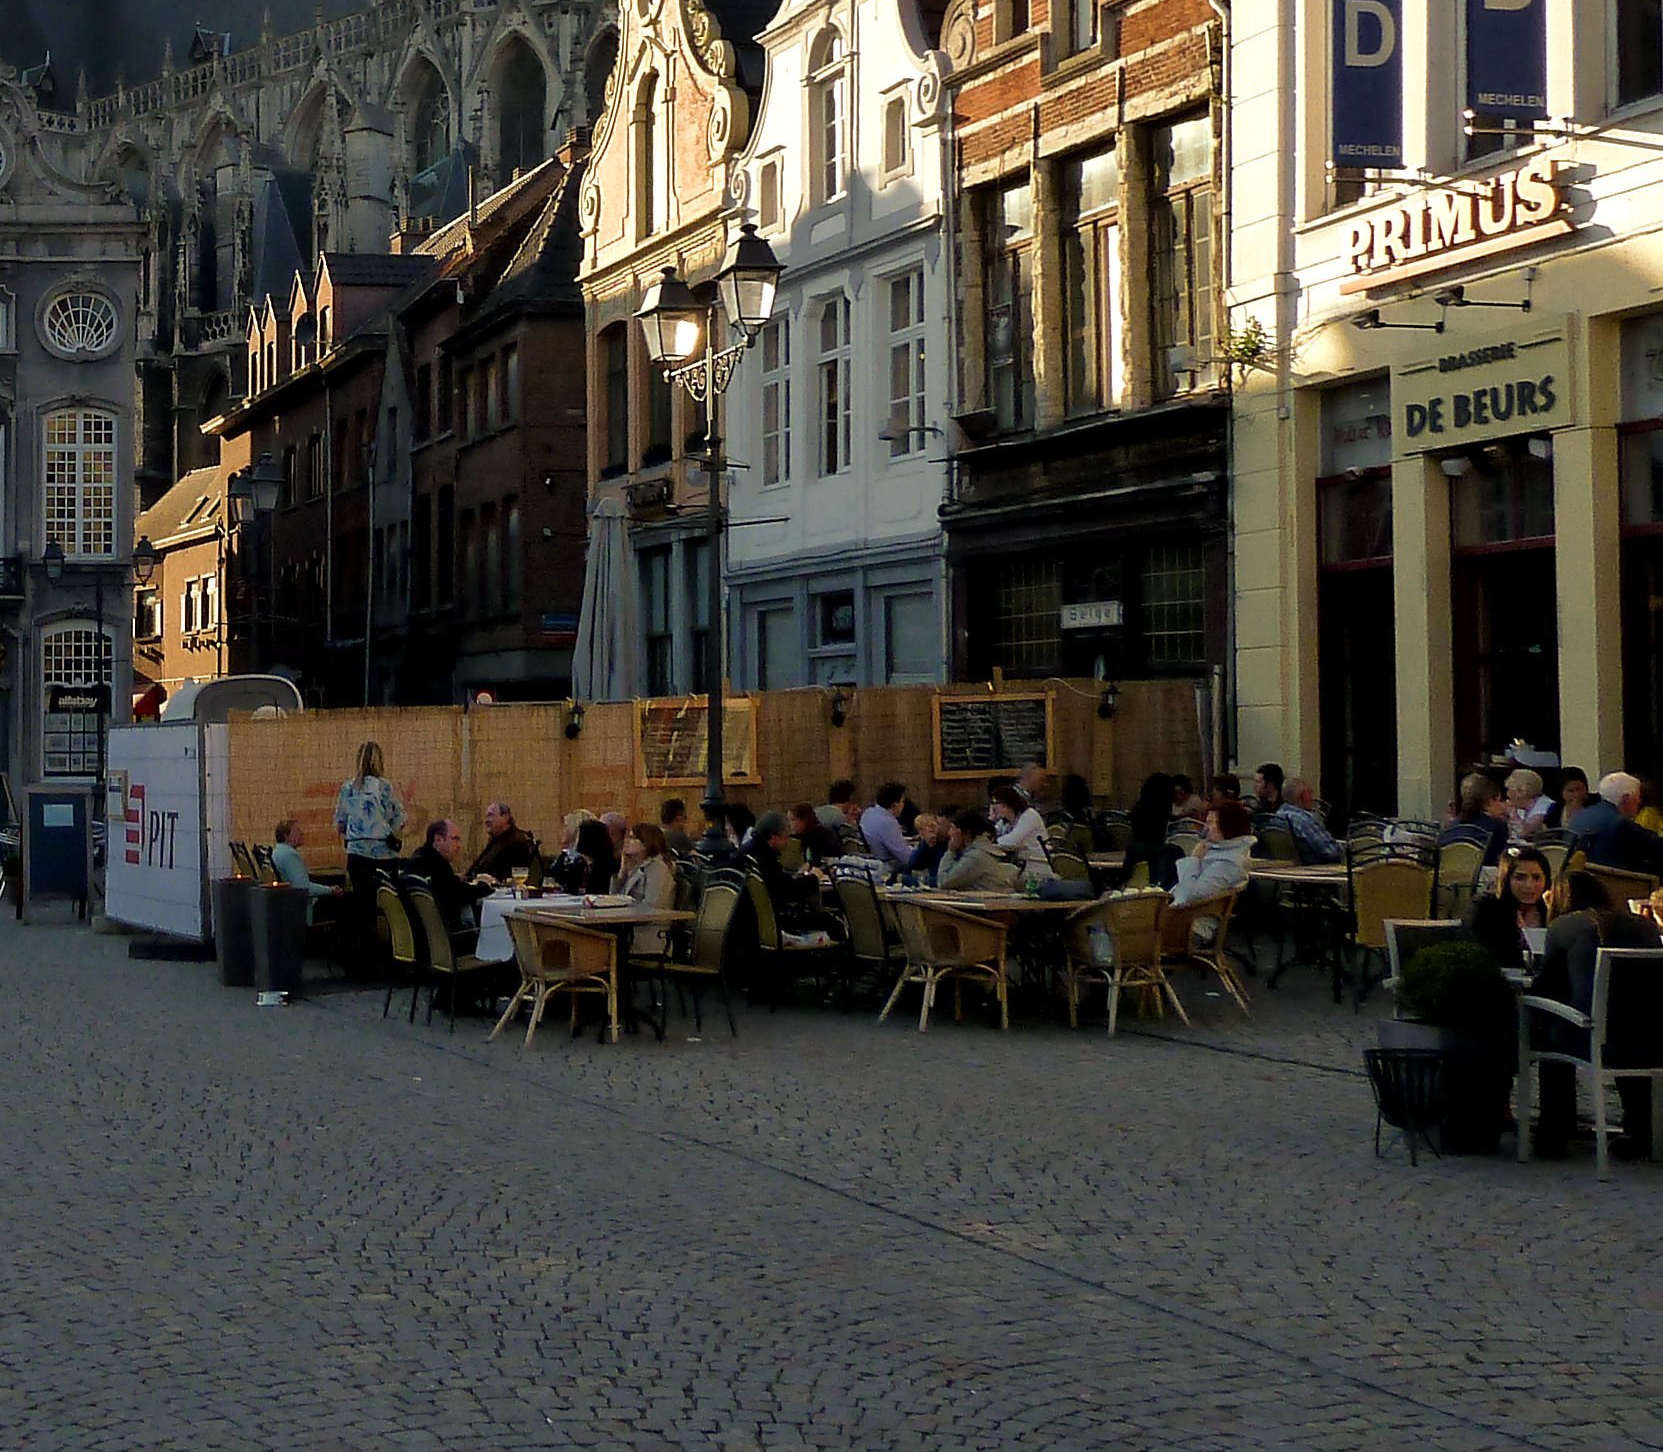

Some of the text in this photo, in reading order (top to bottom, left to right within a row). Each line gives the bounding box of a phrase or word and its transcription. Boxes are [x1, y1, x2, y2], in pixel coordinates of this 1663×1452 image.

[1477, 92, 1544, 109] MECHELEN
[1338, 143, 1401, 157] MECHELEN
[1339, 155, 1558, 276] PRIMUS
[1438, 341, 1518, 373] BRASSERIE
[1405, 396, 1444, 438] DE
[1452, 375, 1556, 429] BEURS
[148, 810, 179, 870] PIT
